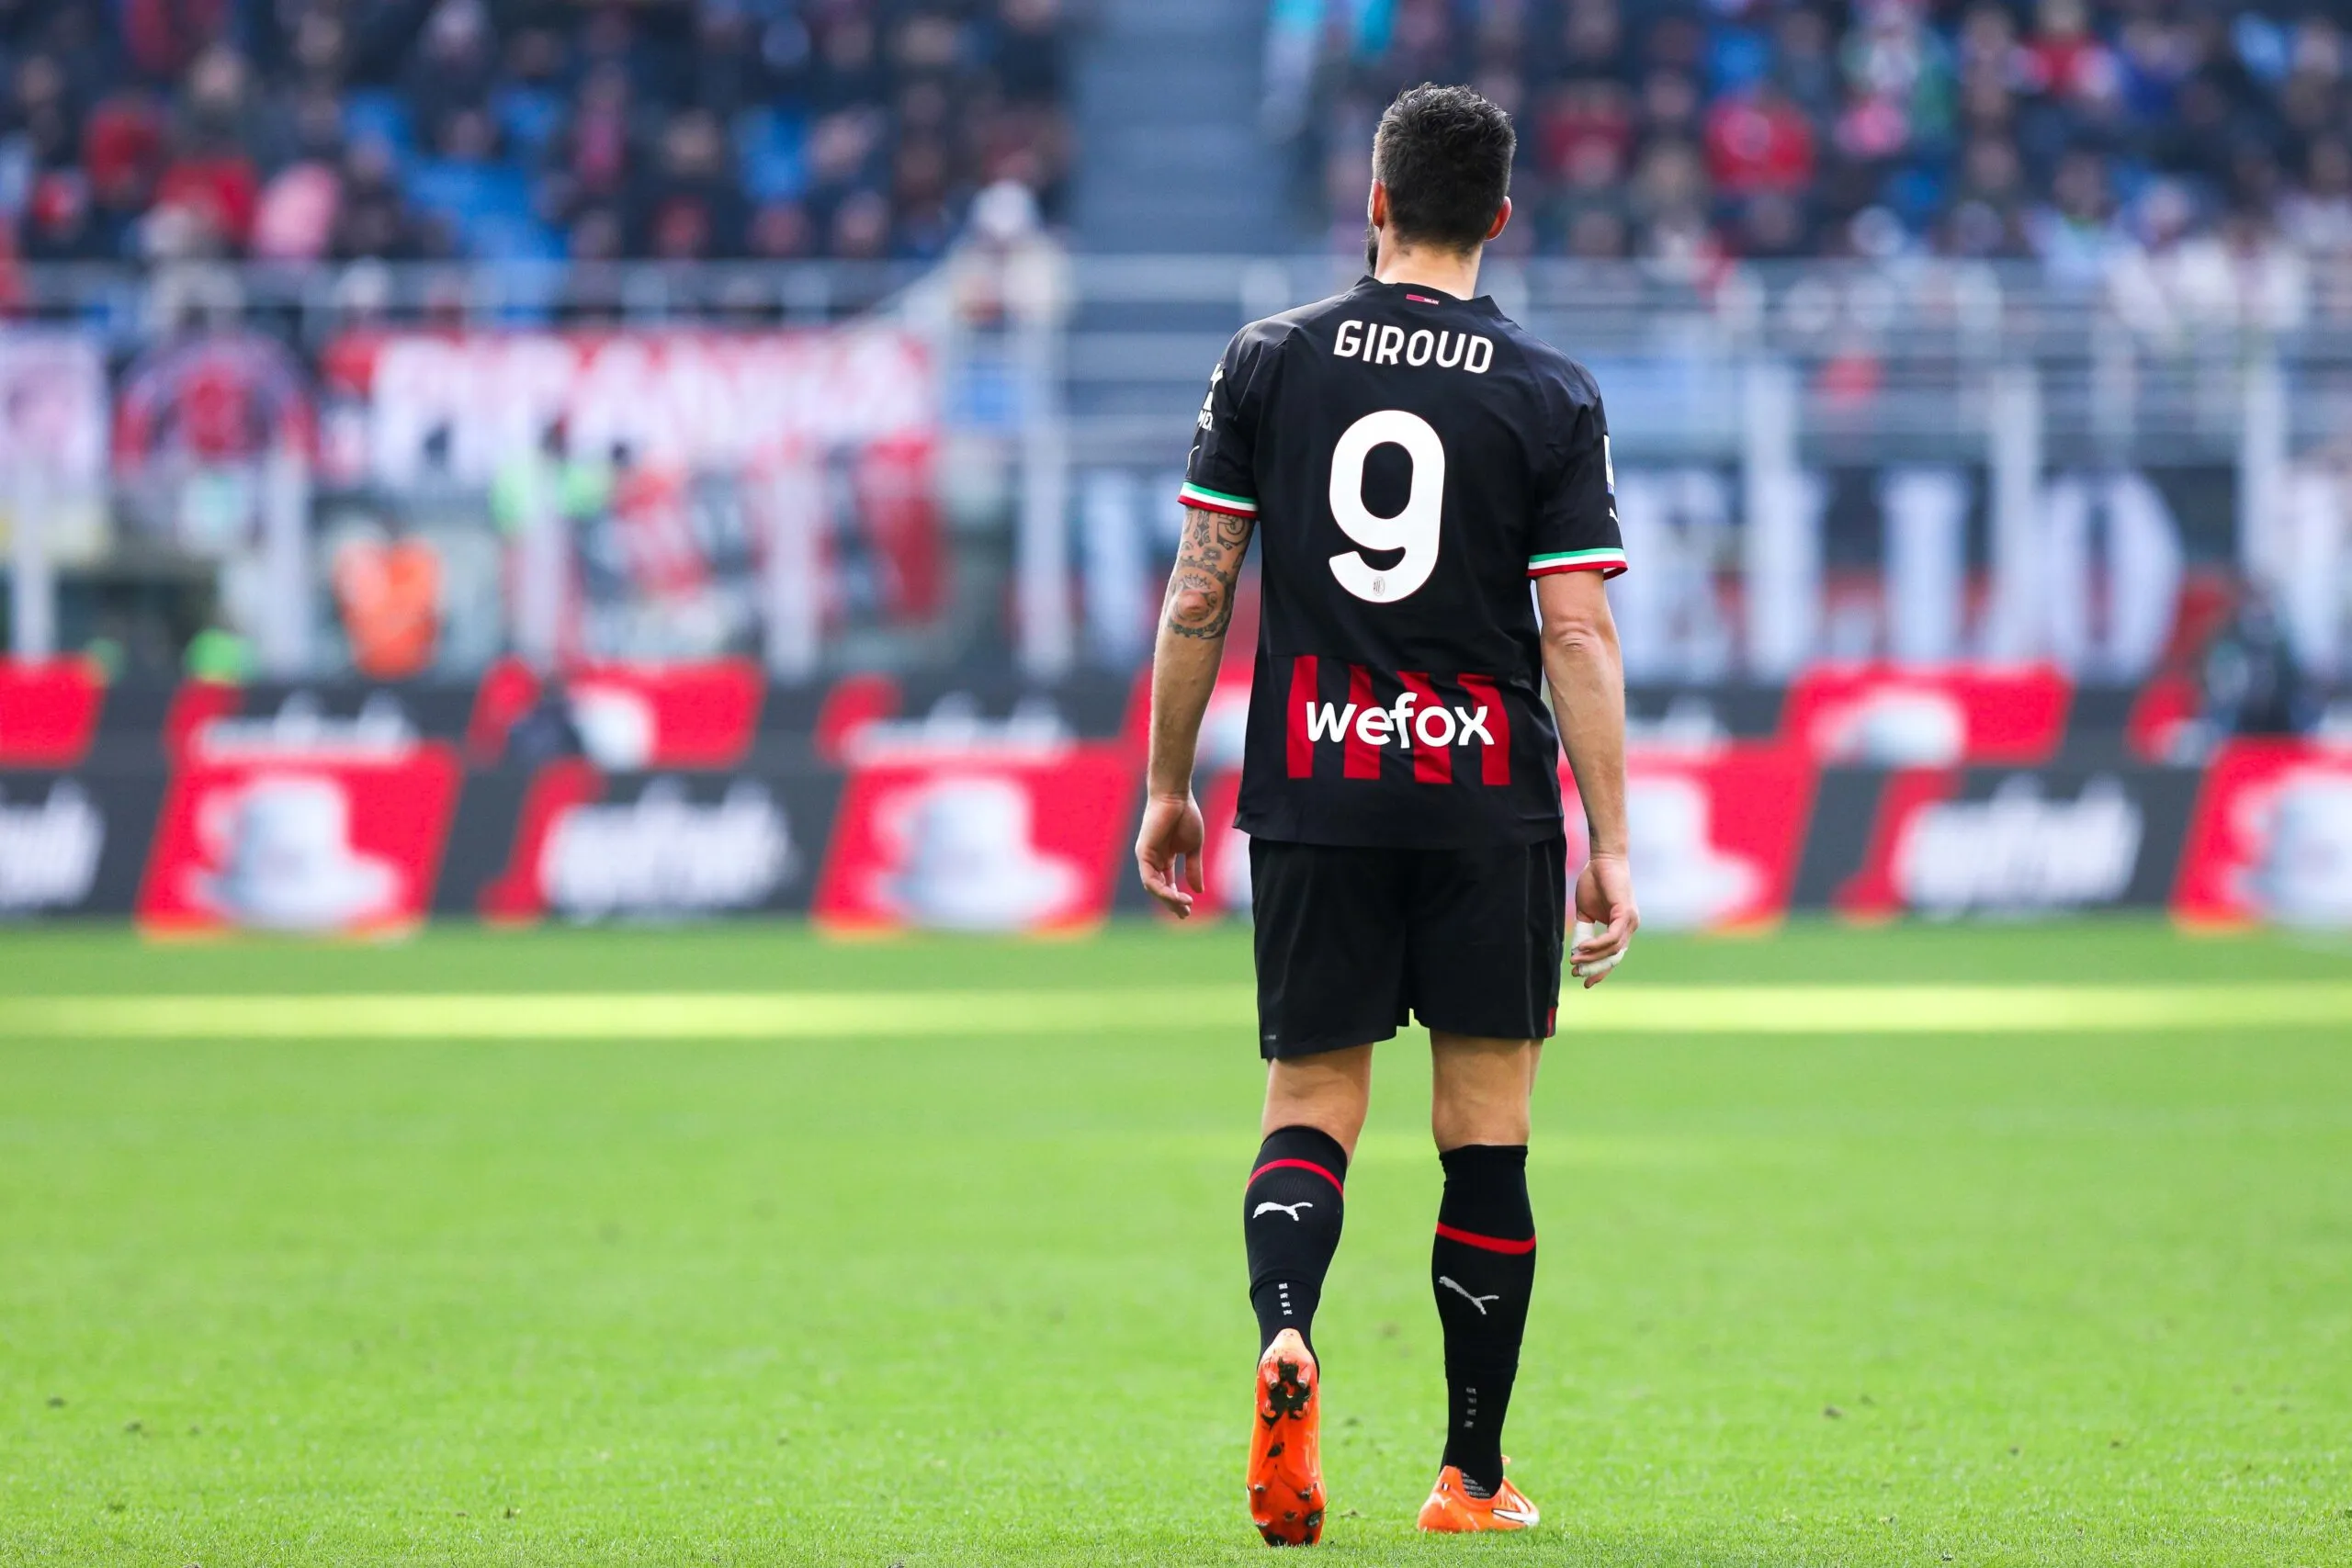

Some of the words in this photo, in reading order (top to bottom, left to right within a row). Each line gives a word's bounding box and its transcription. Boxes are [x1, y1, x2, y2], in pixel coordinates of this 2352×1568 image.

[1333, 320, 1494, 374] GIROUD
[1329, 410, 1446, 604] 9
[1306, 692, 1495, 749] wefox
